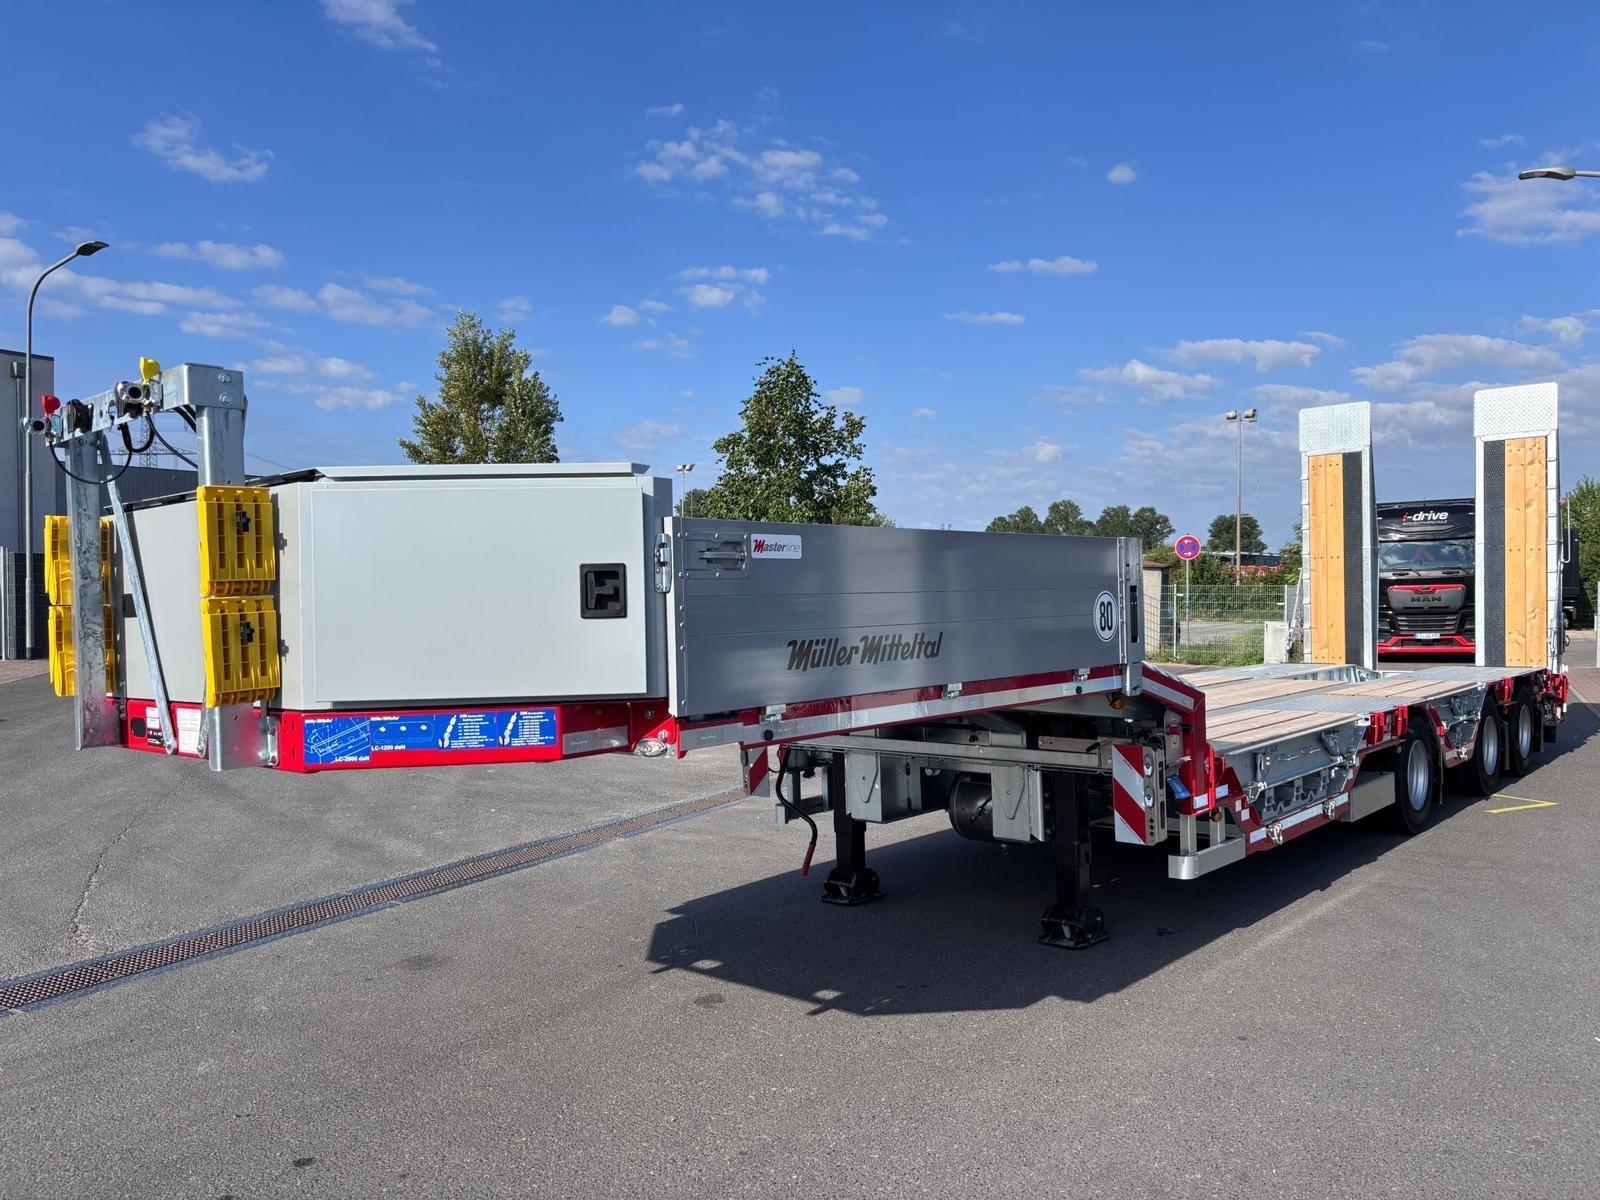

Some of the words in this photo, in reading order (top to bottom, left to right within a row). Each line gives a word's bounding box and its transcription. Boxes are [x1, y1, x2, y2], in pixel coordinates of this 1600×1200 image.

[1402, 510, 1449, 522] i-drive
[753, 539, 801, 553] Masterline
[1100, 601, 1113, 631] 80
